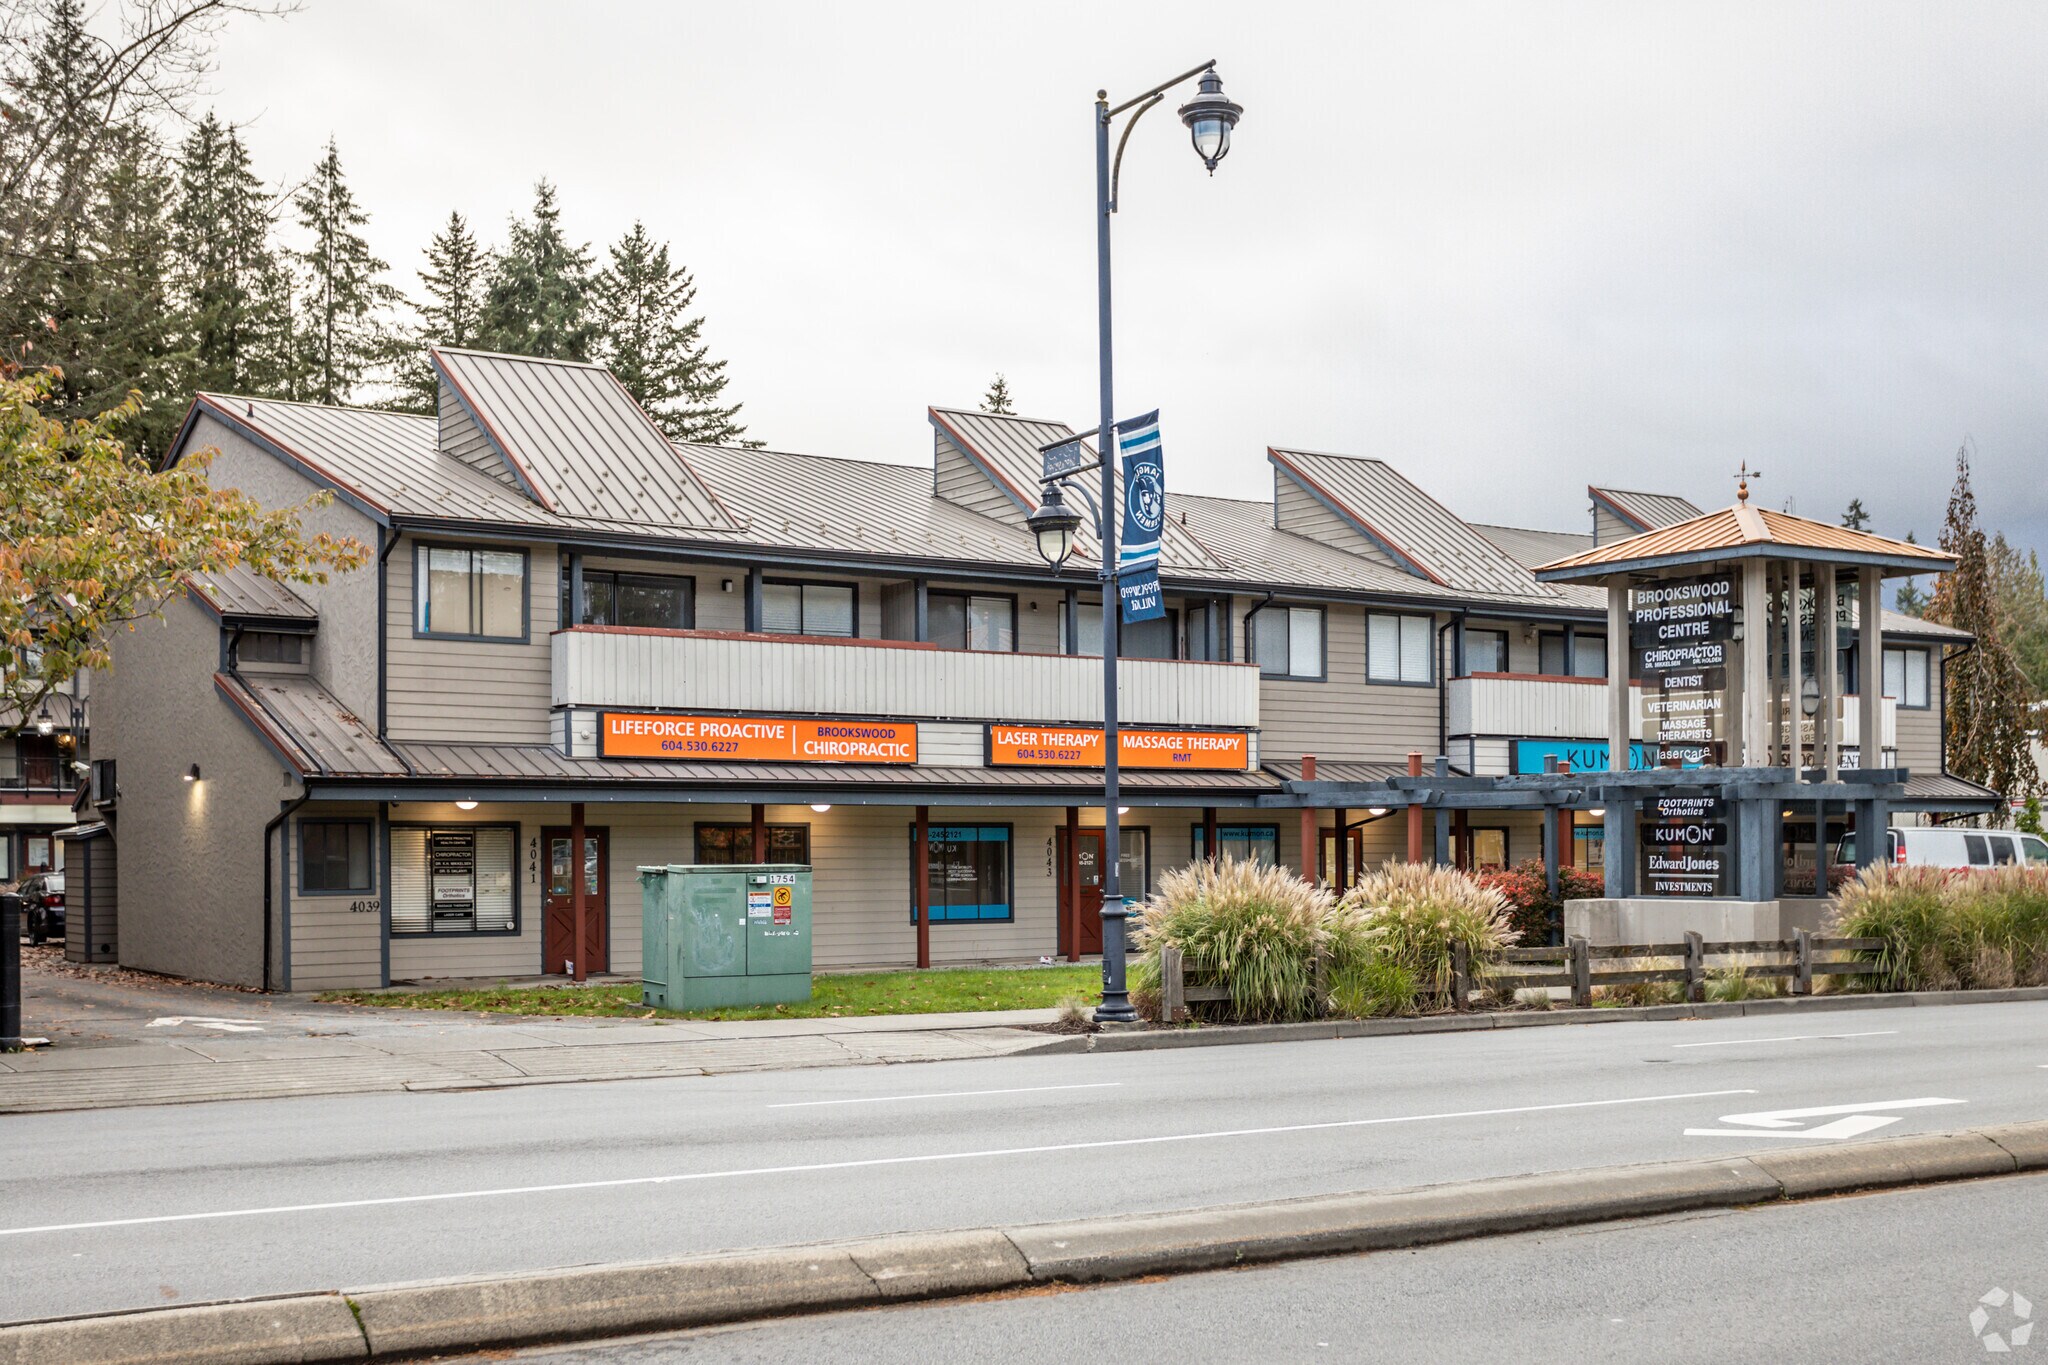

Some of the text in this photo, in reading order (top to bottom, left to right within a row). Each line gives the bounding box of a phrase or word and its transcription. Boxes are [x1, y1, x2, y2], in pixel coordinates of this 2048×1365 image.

[1638, 581, 1730, 604] BROOKSWOOD
[1636, 600, 1732, 622] PROFESSIONAL
[1658, 621, 1710, 639] CENTRE
[1645, 644, 1722, 662] CHIROPRACTOR
[1664, 675, 1703, 688] DENTIST
[1648, 698, 1721, 713] VETERINARIAN
[612, 720, 784, 739] LIFEFORCE PROACTIVE
[1662, 718, 1706, 730] MASSAGE
[818, 726, 896, 739] BROOKSWOOD
[1657, 729, 1712, 740] THERAPISTS
[998, 732, 1099, 747] LASER THERAPY
[1123, 736, 1240, 750] MASSAGE THERAPY
[661, 740, 739, 753] 604.530.6227
[804, 741, 910, 757] CHIROPRACTIC
[1017, 749, 1081, 760] 604.530.6227
[1172, 754, 1192, 762] RMT
[1656, 746, 1712, 762] lasercare
[1658, 798, 1714, 808] FOOTPRINTS
[1662, 808, 1704, 816] Orthotics
[1656, 825, 1713, 844] KUMON
[529, 837, 538, 884] 4041
[771, 875, 794, 883] 1754
[1655, 882, 1712, 892] INVESTMENTS
[350, 900, 380, 912] 4039
